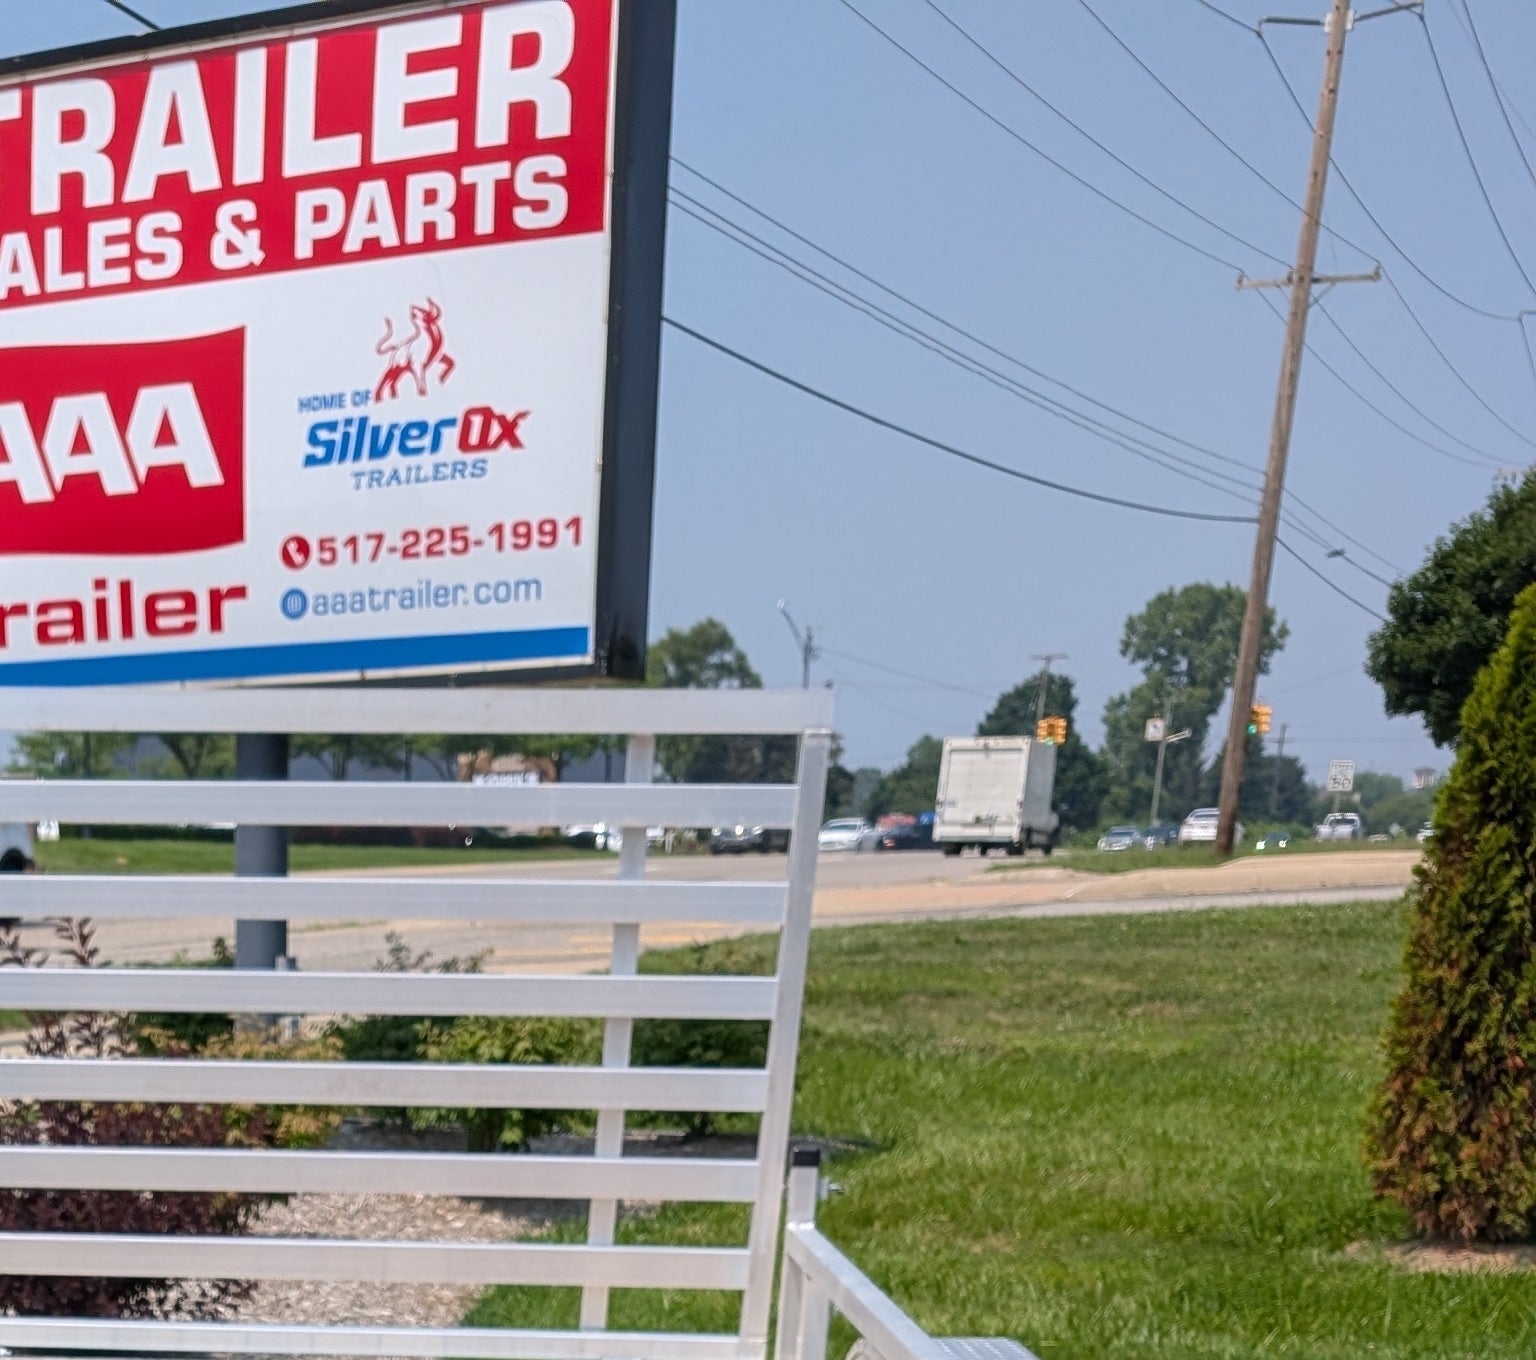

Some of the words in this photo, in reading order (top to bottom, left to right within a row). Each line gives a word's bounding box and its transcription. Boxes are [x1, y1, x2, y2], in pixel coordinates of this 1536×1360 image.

[210, 201, 266, 268] &
[294, 156, 569, 260] PARTS
[297, 391, 346, 413] HOME
[350, 388, 371, 407] OF
[351, 459, 489, 490] TRAILERS
[318, 516, 583, 566] 517-225-1991
[313, 577, 543, 617] aaatrailer.com
